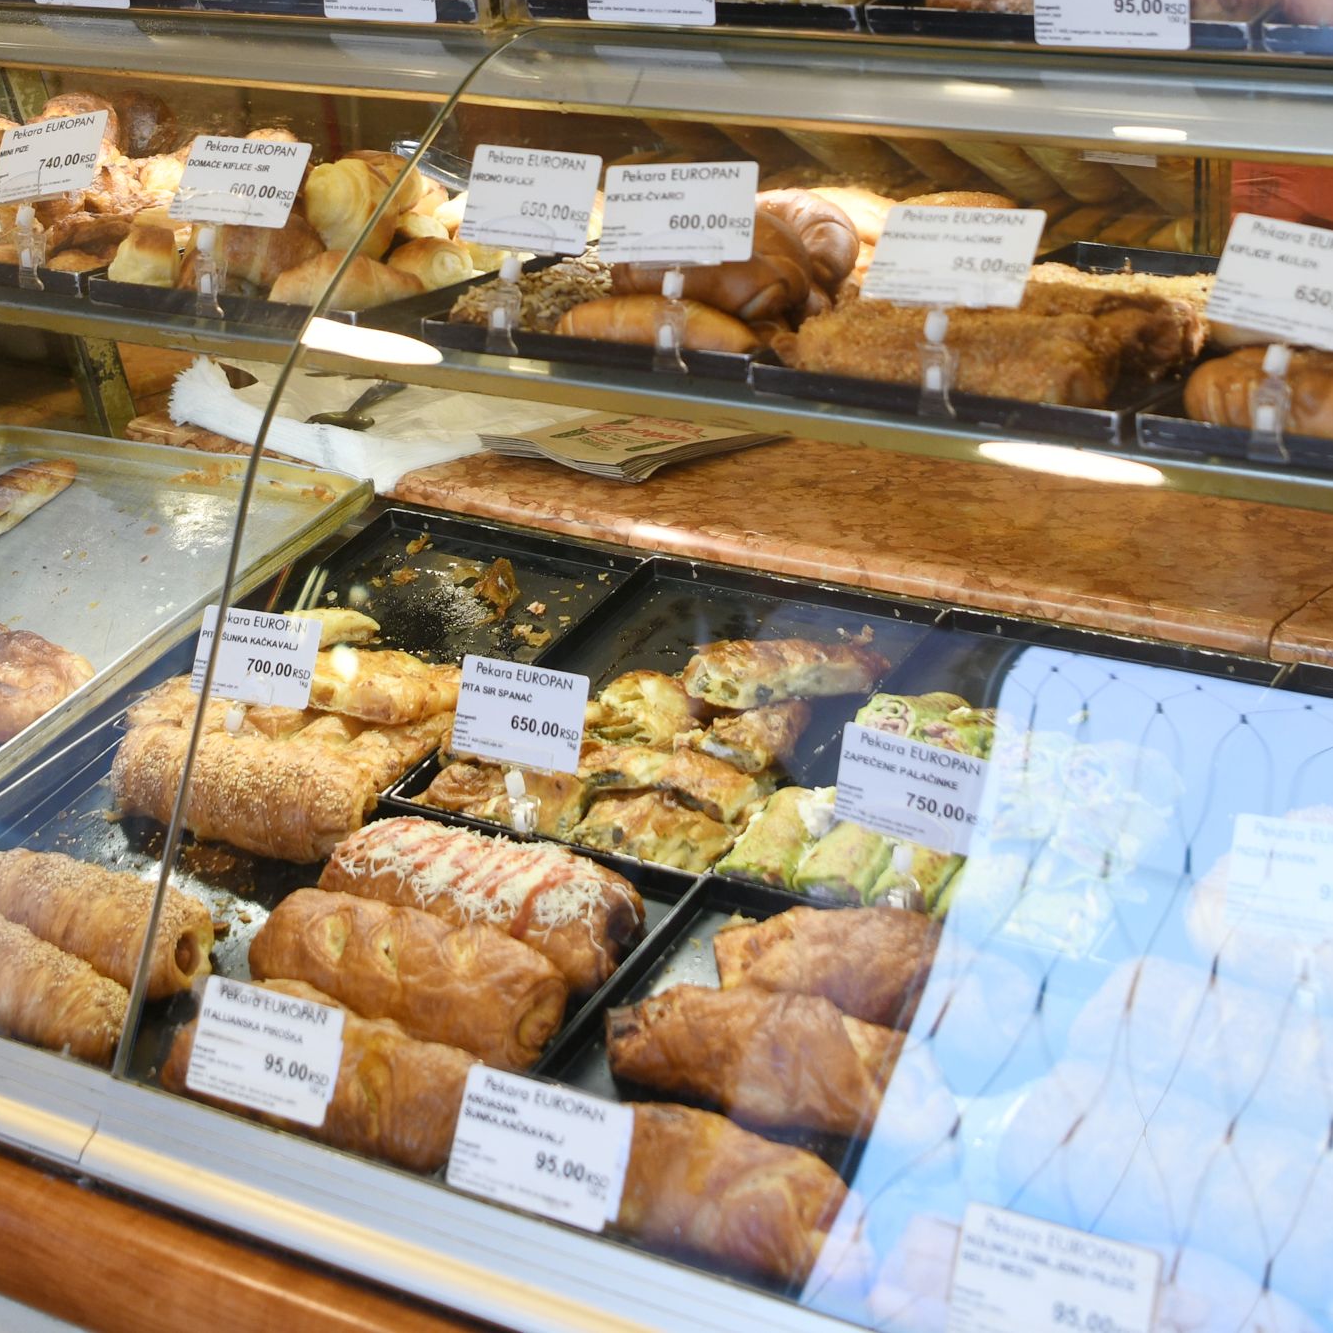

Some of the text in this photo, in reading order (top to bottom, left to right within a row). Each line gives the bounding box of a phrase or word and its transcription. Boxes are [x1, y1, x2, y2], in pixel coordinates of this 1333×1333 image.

[13, 116, 95, 140] Pekara EUROPAN
[0, 148, 13, 158] MINI
[205, 141, 297, 157] Pekara EUROPAN
[487, 150, 586, 171] Pekara EUROPAN
[622, 167, 740, 183] Pekara EUROPAN
[669, 215, 728, 231] 600,00
[903, 210, 1025, 225] Pekara EUROPAN
[1252, 222, 1303, 244] Pekara
[247, 658, 292, 677] 700,00
[476, 662, 573, 690] Pekara EUROPAN
[462, 682, 480, 692] PITA
[483, 686, 495, 695] SIR
[511, 715, 559, 737] 650,00
[861, 732, 980, 775] Pekara EUROPAN
[220, 984, 328, 1026] Pekara EUROPAN
[485, 1075, 606, 1122] Pekara EUROPAN
